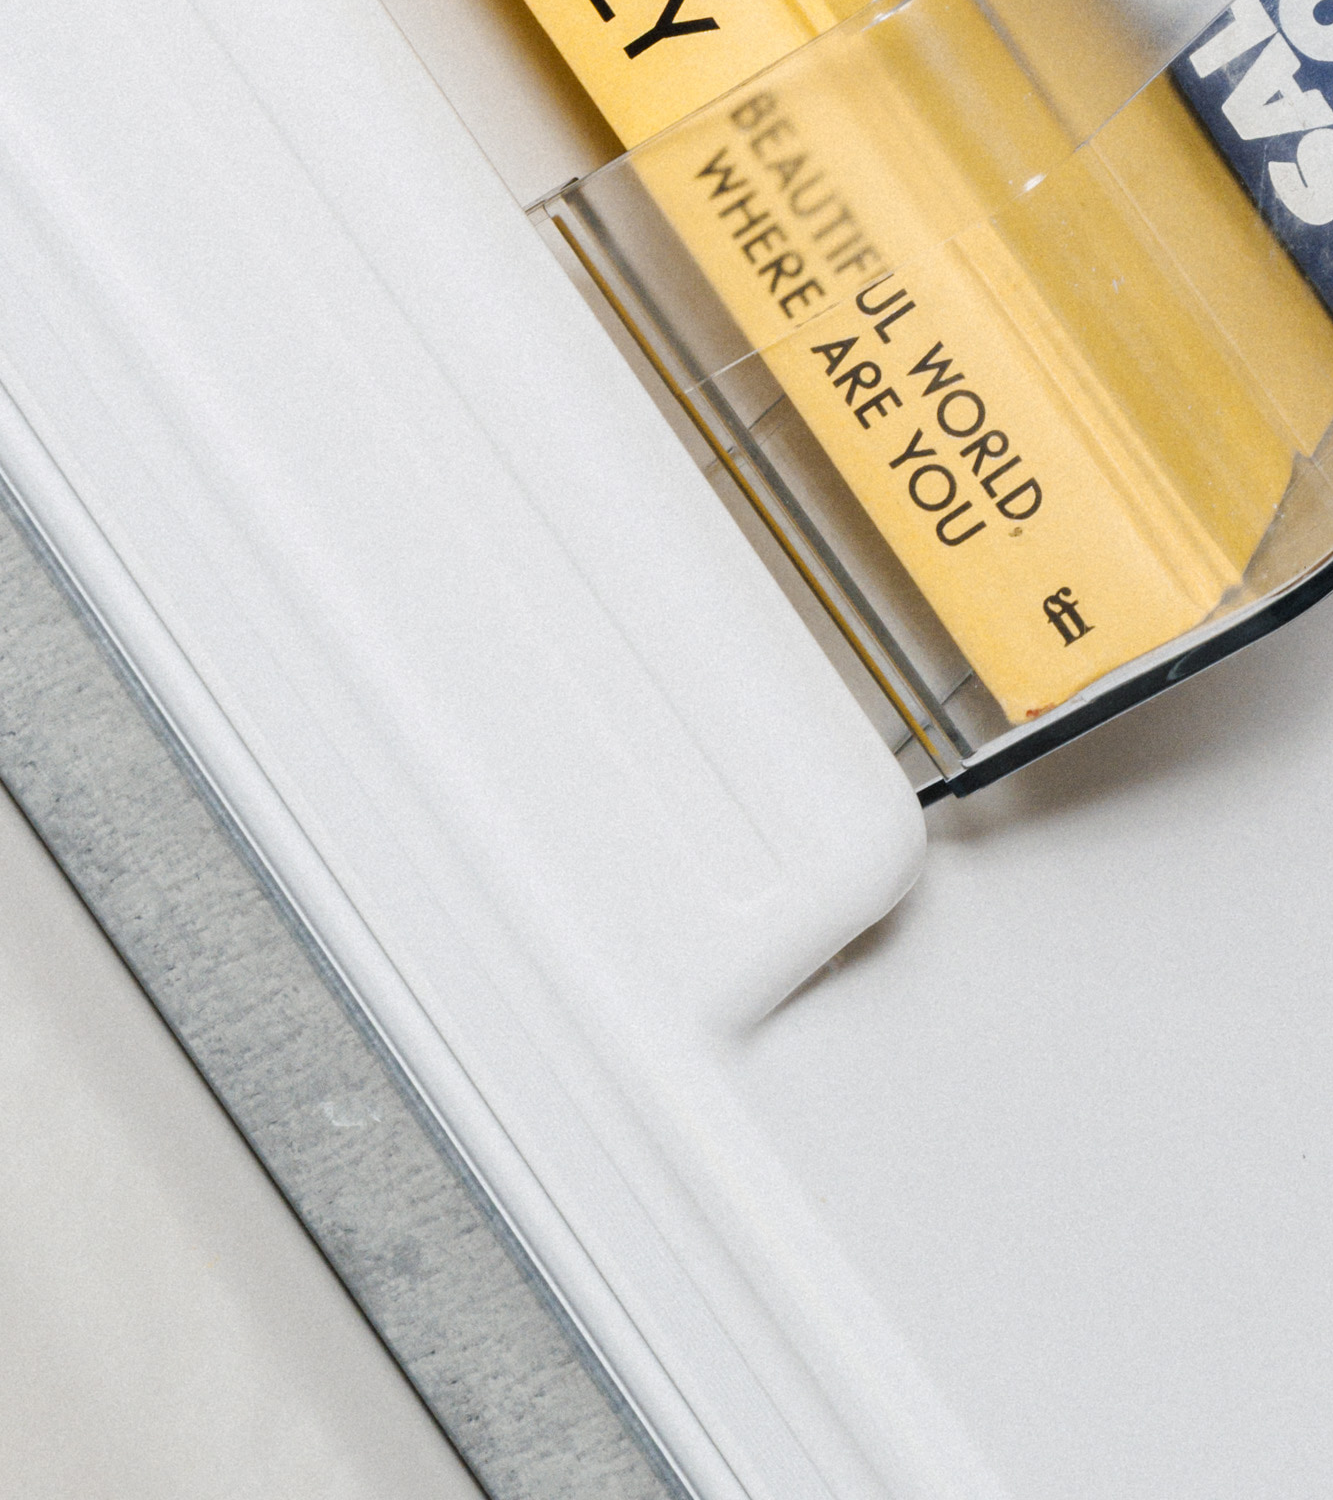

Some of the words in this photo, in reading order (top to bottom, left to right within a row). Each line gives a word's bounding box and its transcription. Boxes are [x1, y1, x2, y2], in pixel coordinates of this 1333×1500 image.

[695, 146, 825, 320] WHERE
[810, 335, 904, 430] ARE
[889, 427, 988, 548] YOU
[730, 88, 918, 344] BEAUTIFUL
[907, 340, 1044, 538] WORLD,
